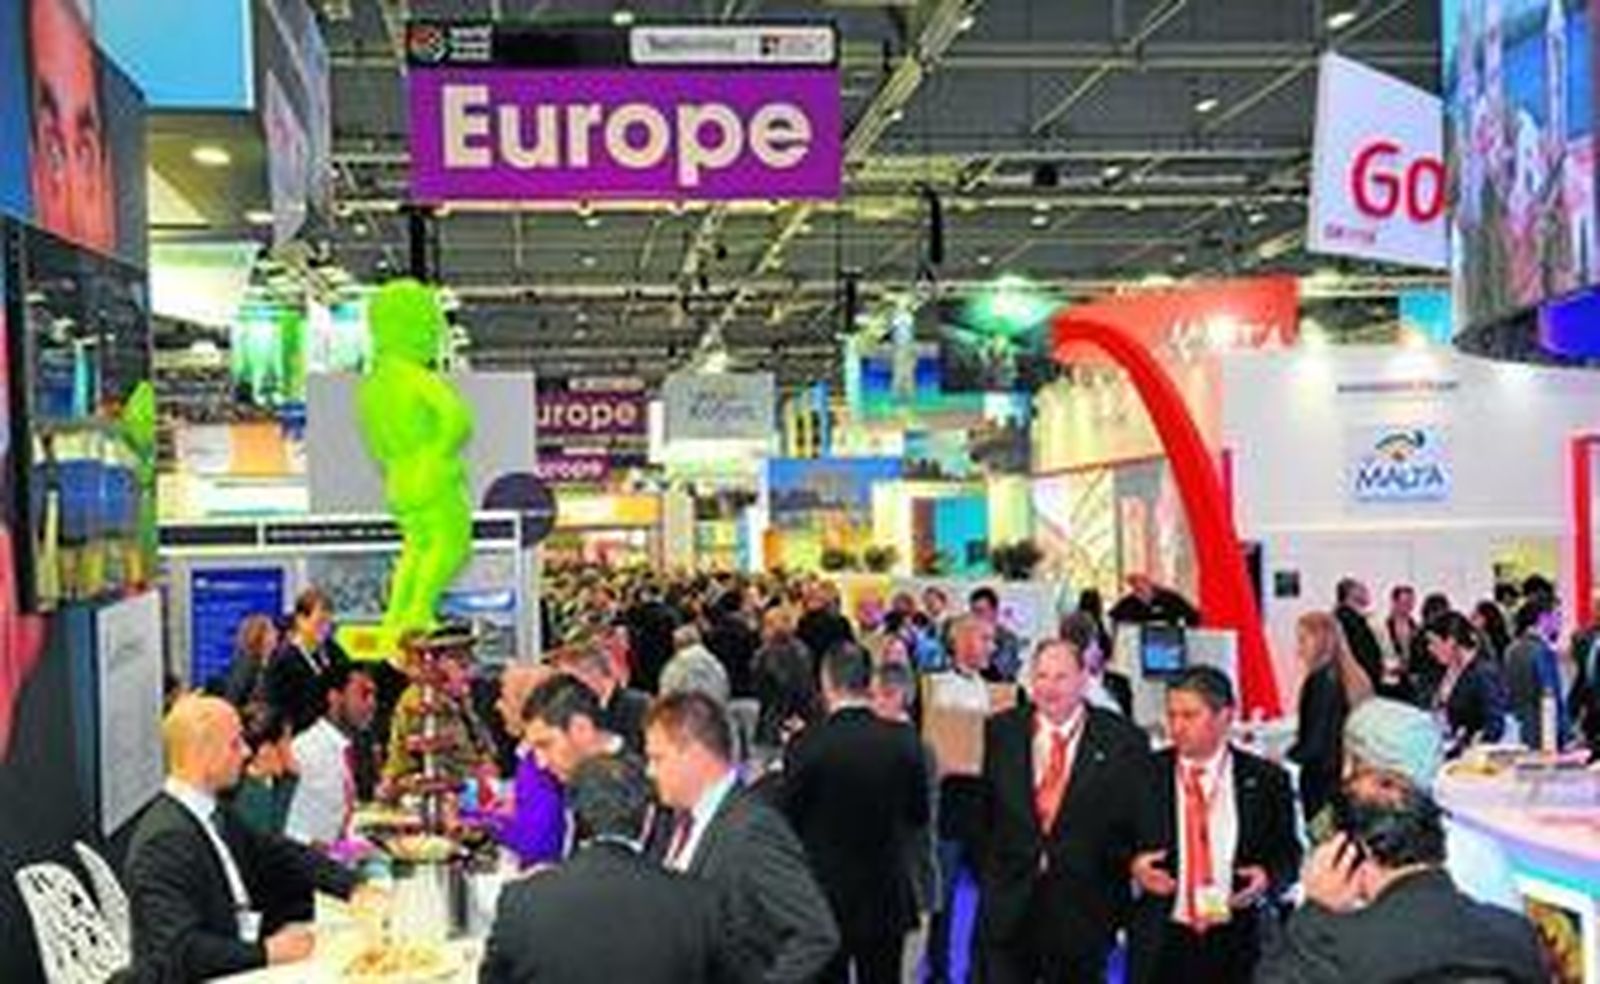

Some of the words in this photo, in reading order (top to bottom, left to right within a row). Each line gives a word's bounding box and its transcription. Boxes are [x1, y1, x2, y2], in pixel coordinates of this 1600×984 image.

[441, 84, 813, 186] Europe
[1351, 143, 1446, 223] Go
[536, 403, 637, 430] urope
[1356, 464, 1445, 492] MALTA
